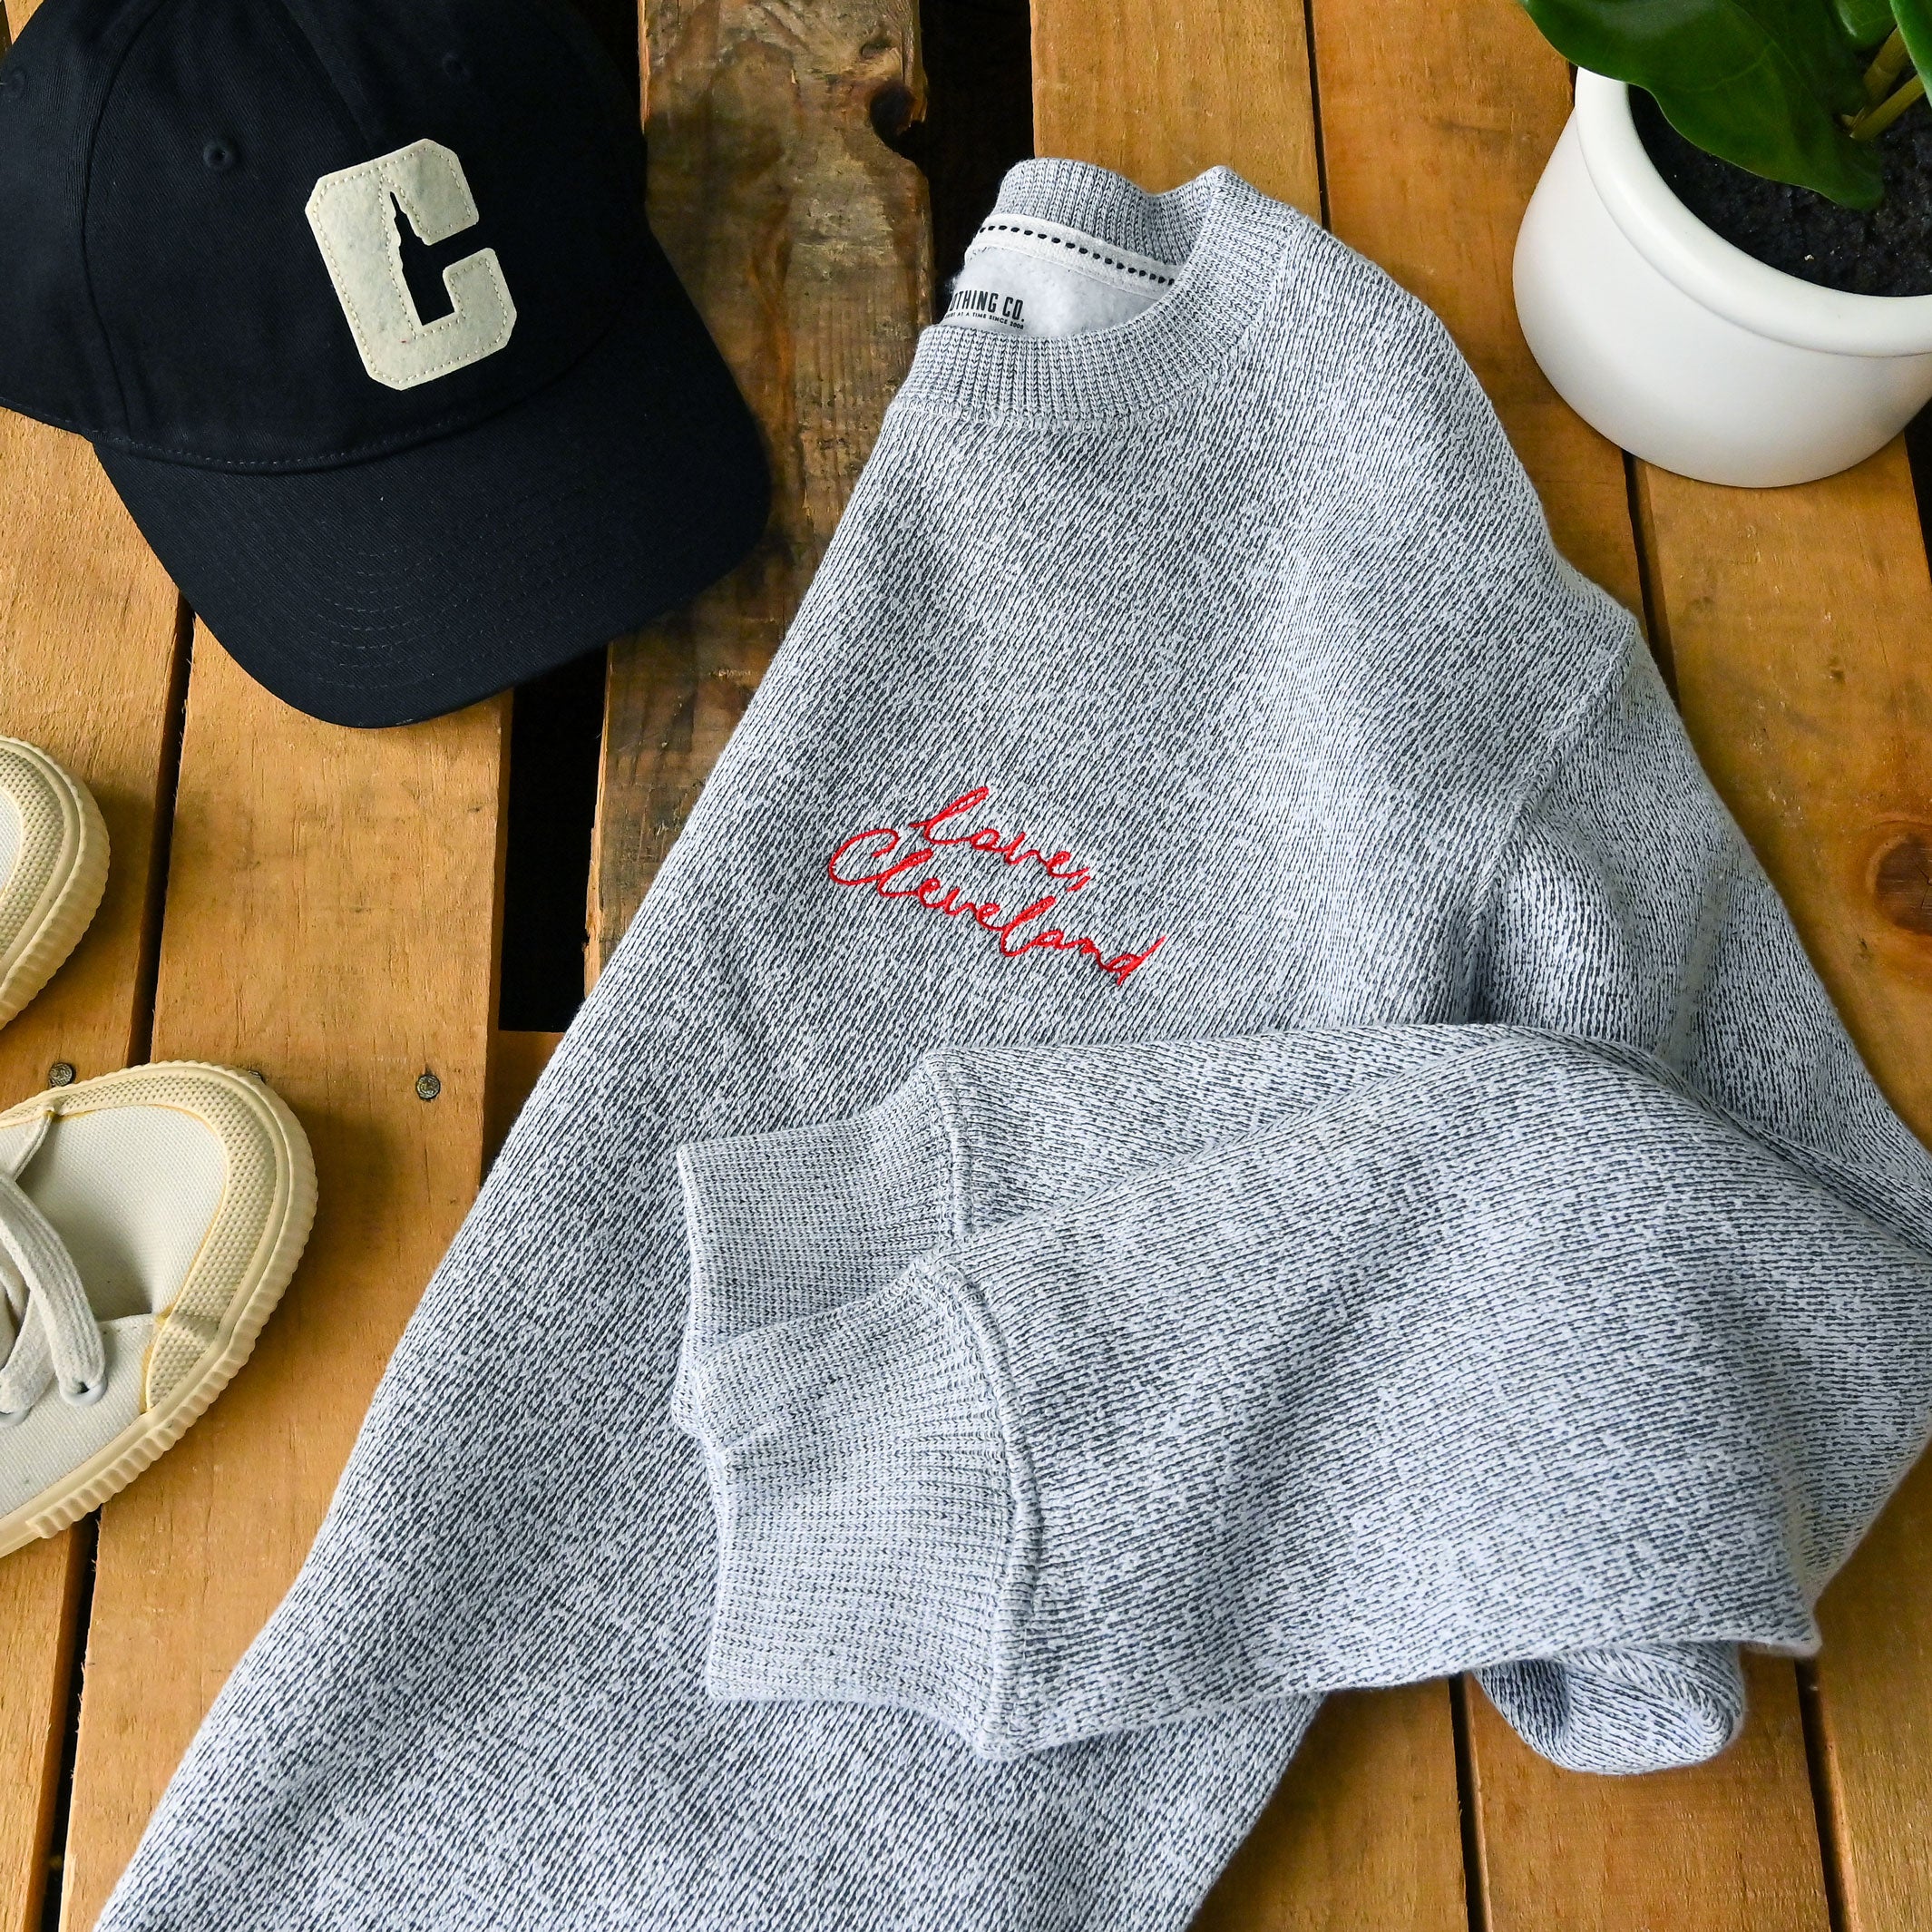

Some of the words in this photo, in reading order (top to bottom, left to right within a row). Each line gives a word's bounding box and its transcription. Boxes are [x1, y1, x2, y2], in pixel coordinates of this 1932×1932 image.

[305, 138, 518, 391] C
[1002, 296, 1025, 323] CO.
[989, 315, 1008, 325] SINCE
[828, 827, 1166, 986] Cleveland
